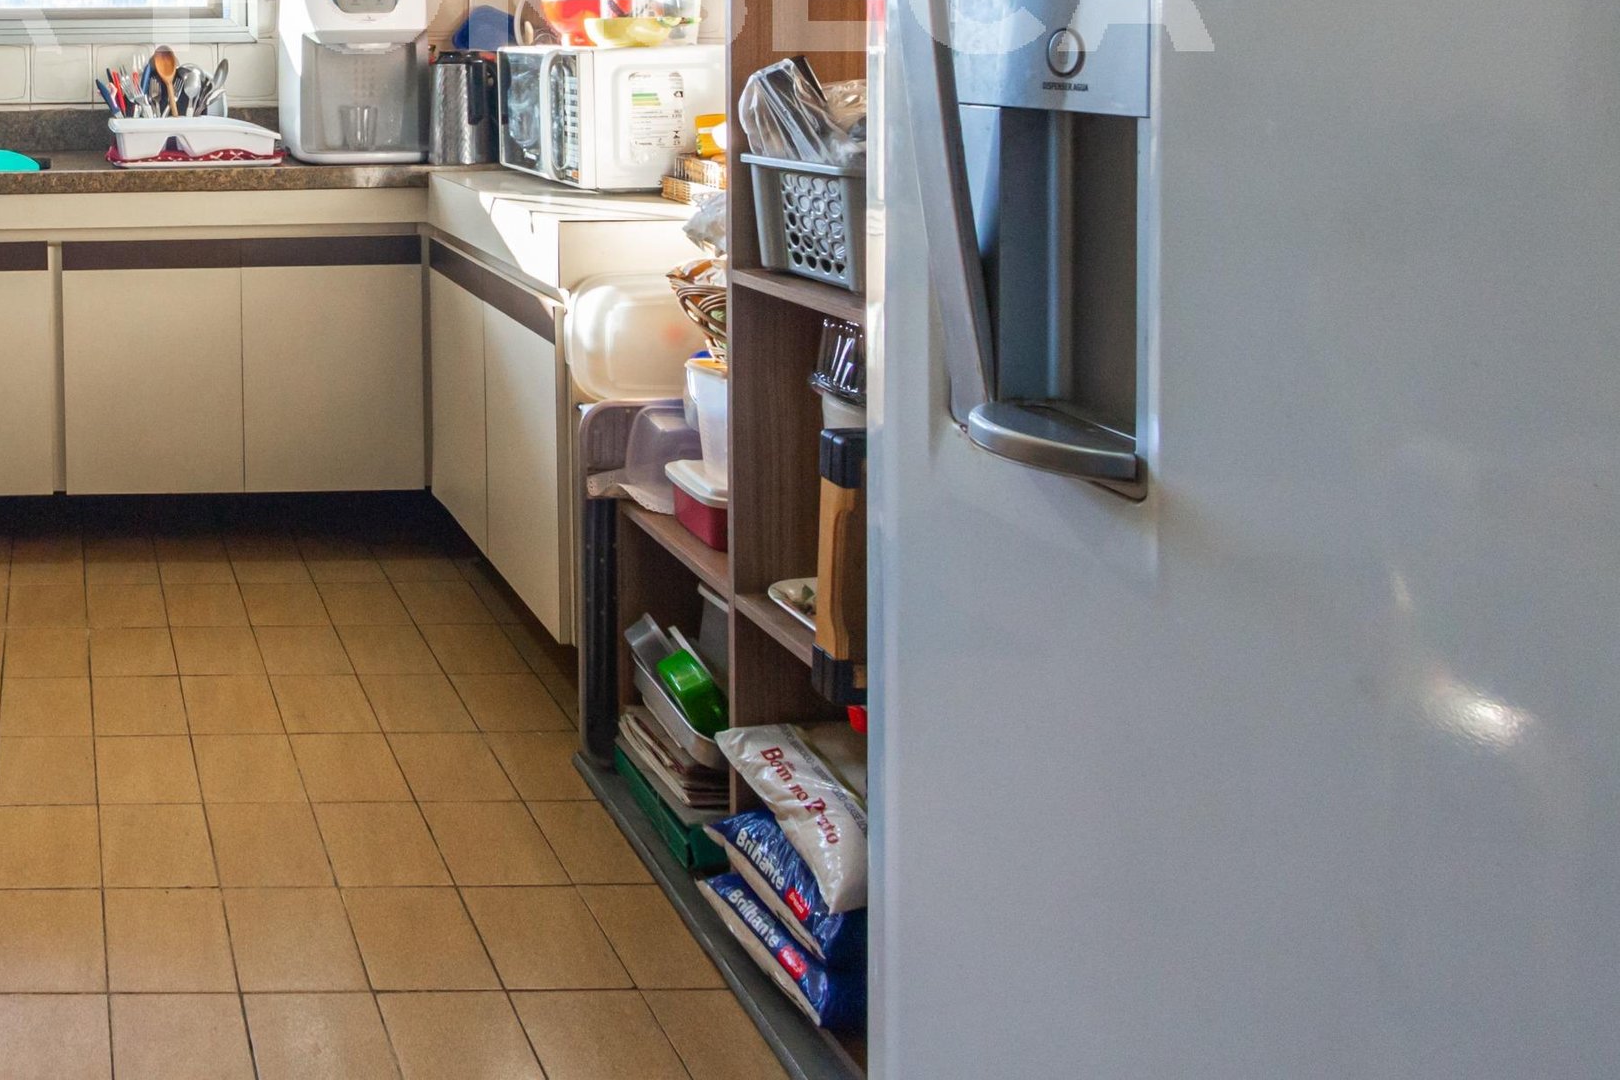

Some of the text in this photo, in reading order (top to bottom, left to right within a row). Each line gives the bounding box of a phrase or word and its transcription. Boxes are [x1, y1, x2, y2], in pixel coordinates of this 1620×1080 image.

[760, 746, 793, 783] Bom
[789, 784, 809, 802] no
[735, 828, 785, 890] Brilhante
[729, 888, 780, 948] Brilhante
